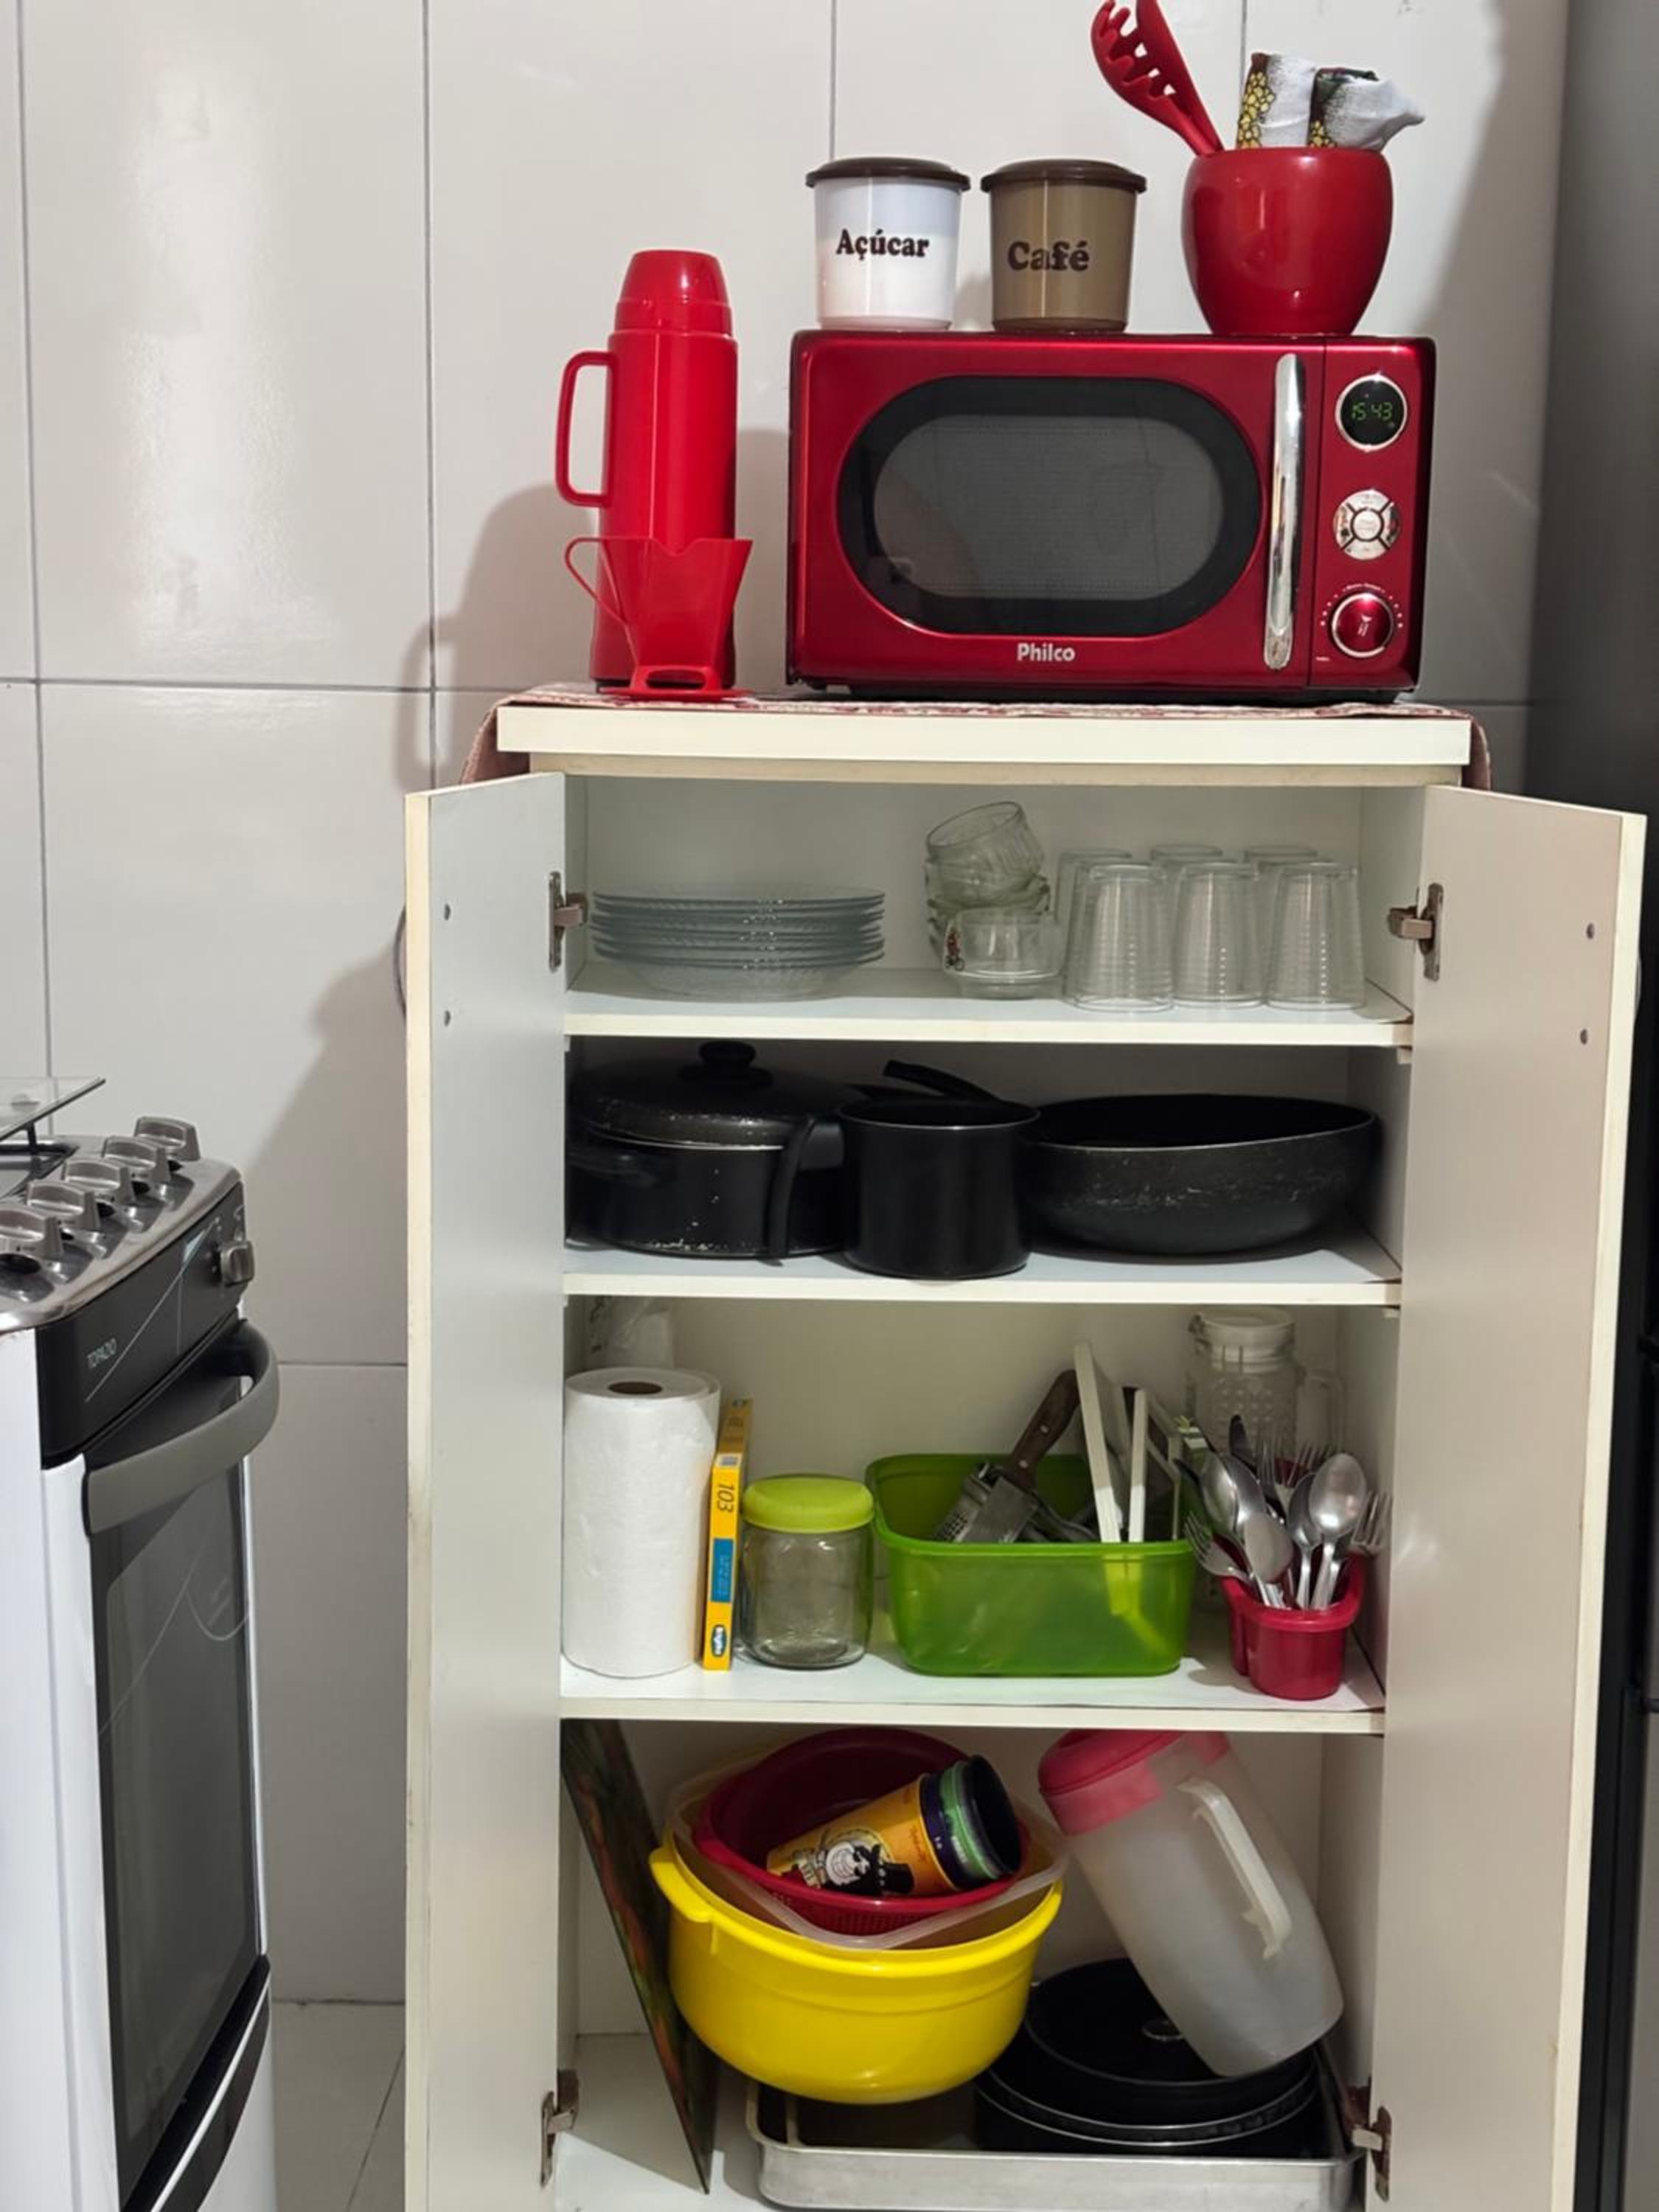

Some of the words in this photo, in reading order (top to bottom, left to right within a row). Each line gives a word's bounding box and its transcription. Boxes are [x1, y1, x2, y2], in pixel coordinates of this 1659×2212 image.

[836, 229, 929, 260] Açúcar
[1007, 240, 1090, 271] Café
[1017, 642, 1076, 661] Philco
[717, 1483, 734, 1512] 103
